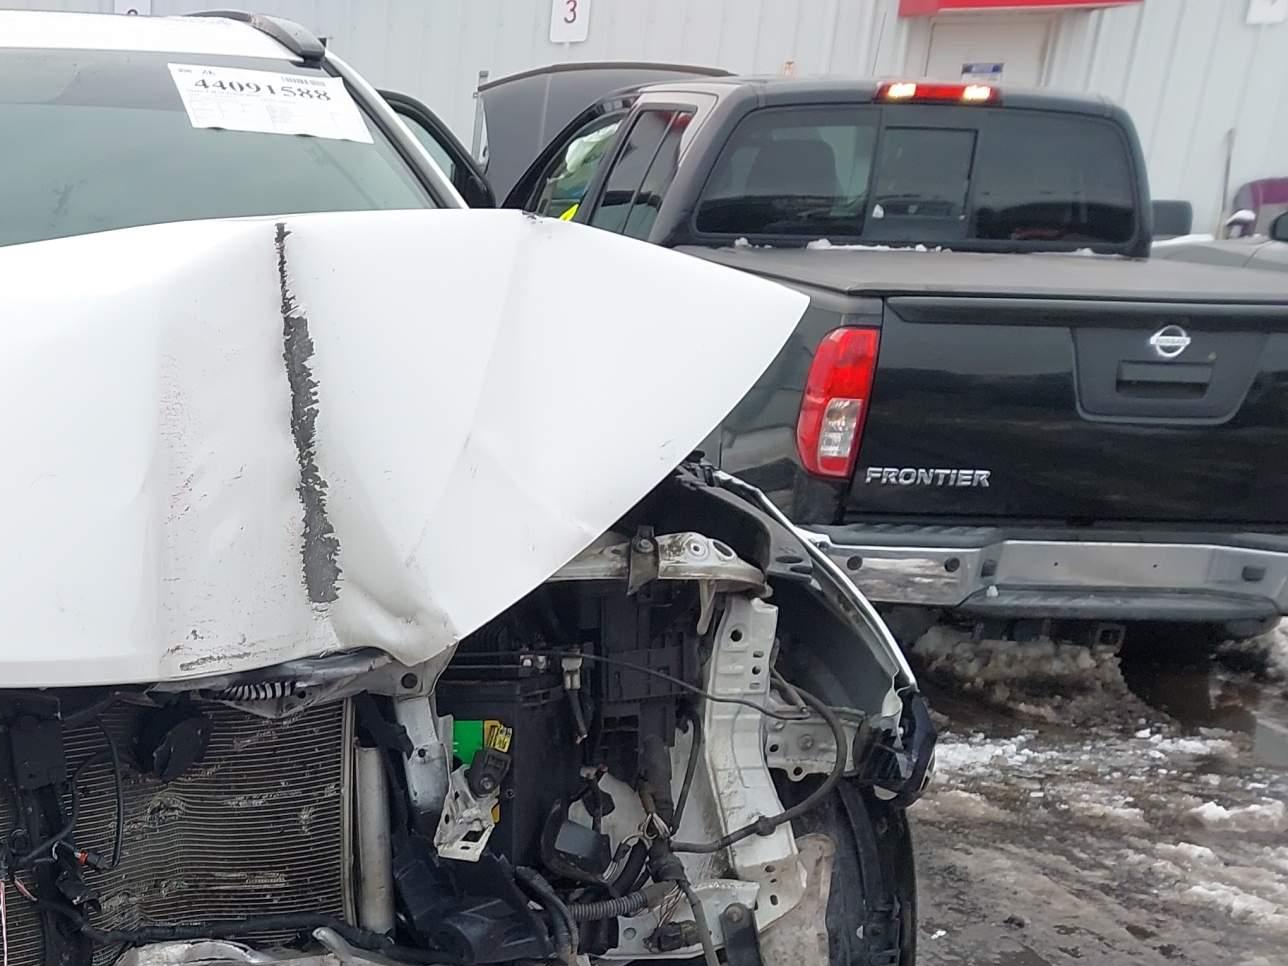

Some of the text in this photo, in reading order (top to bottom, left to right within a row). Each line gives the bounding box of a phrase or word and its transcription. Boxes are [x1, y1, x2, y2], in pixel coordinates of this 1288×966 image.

[564, 0, 577, 24] 3
[194, 78, 332, 102] 44091588
[865, 466, 991, 487] FRONTIER
